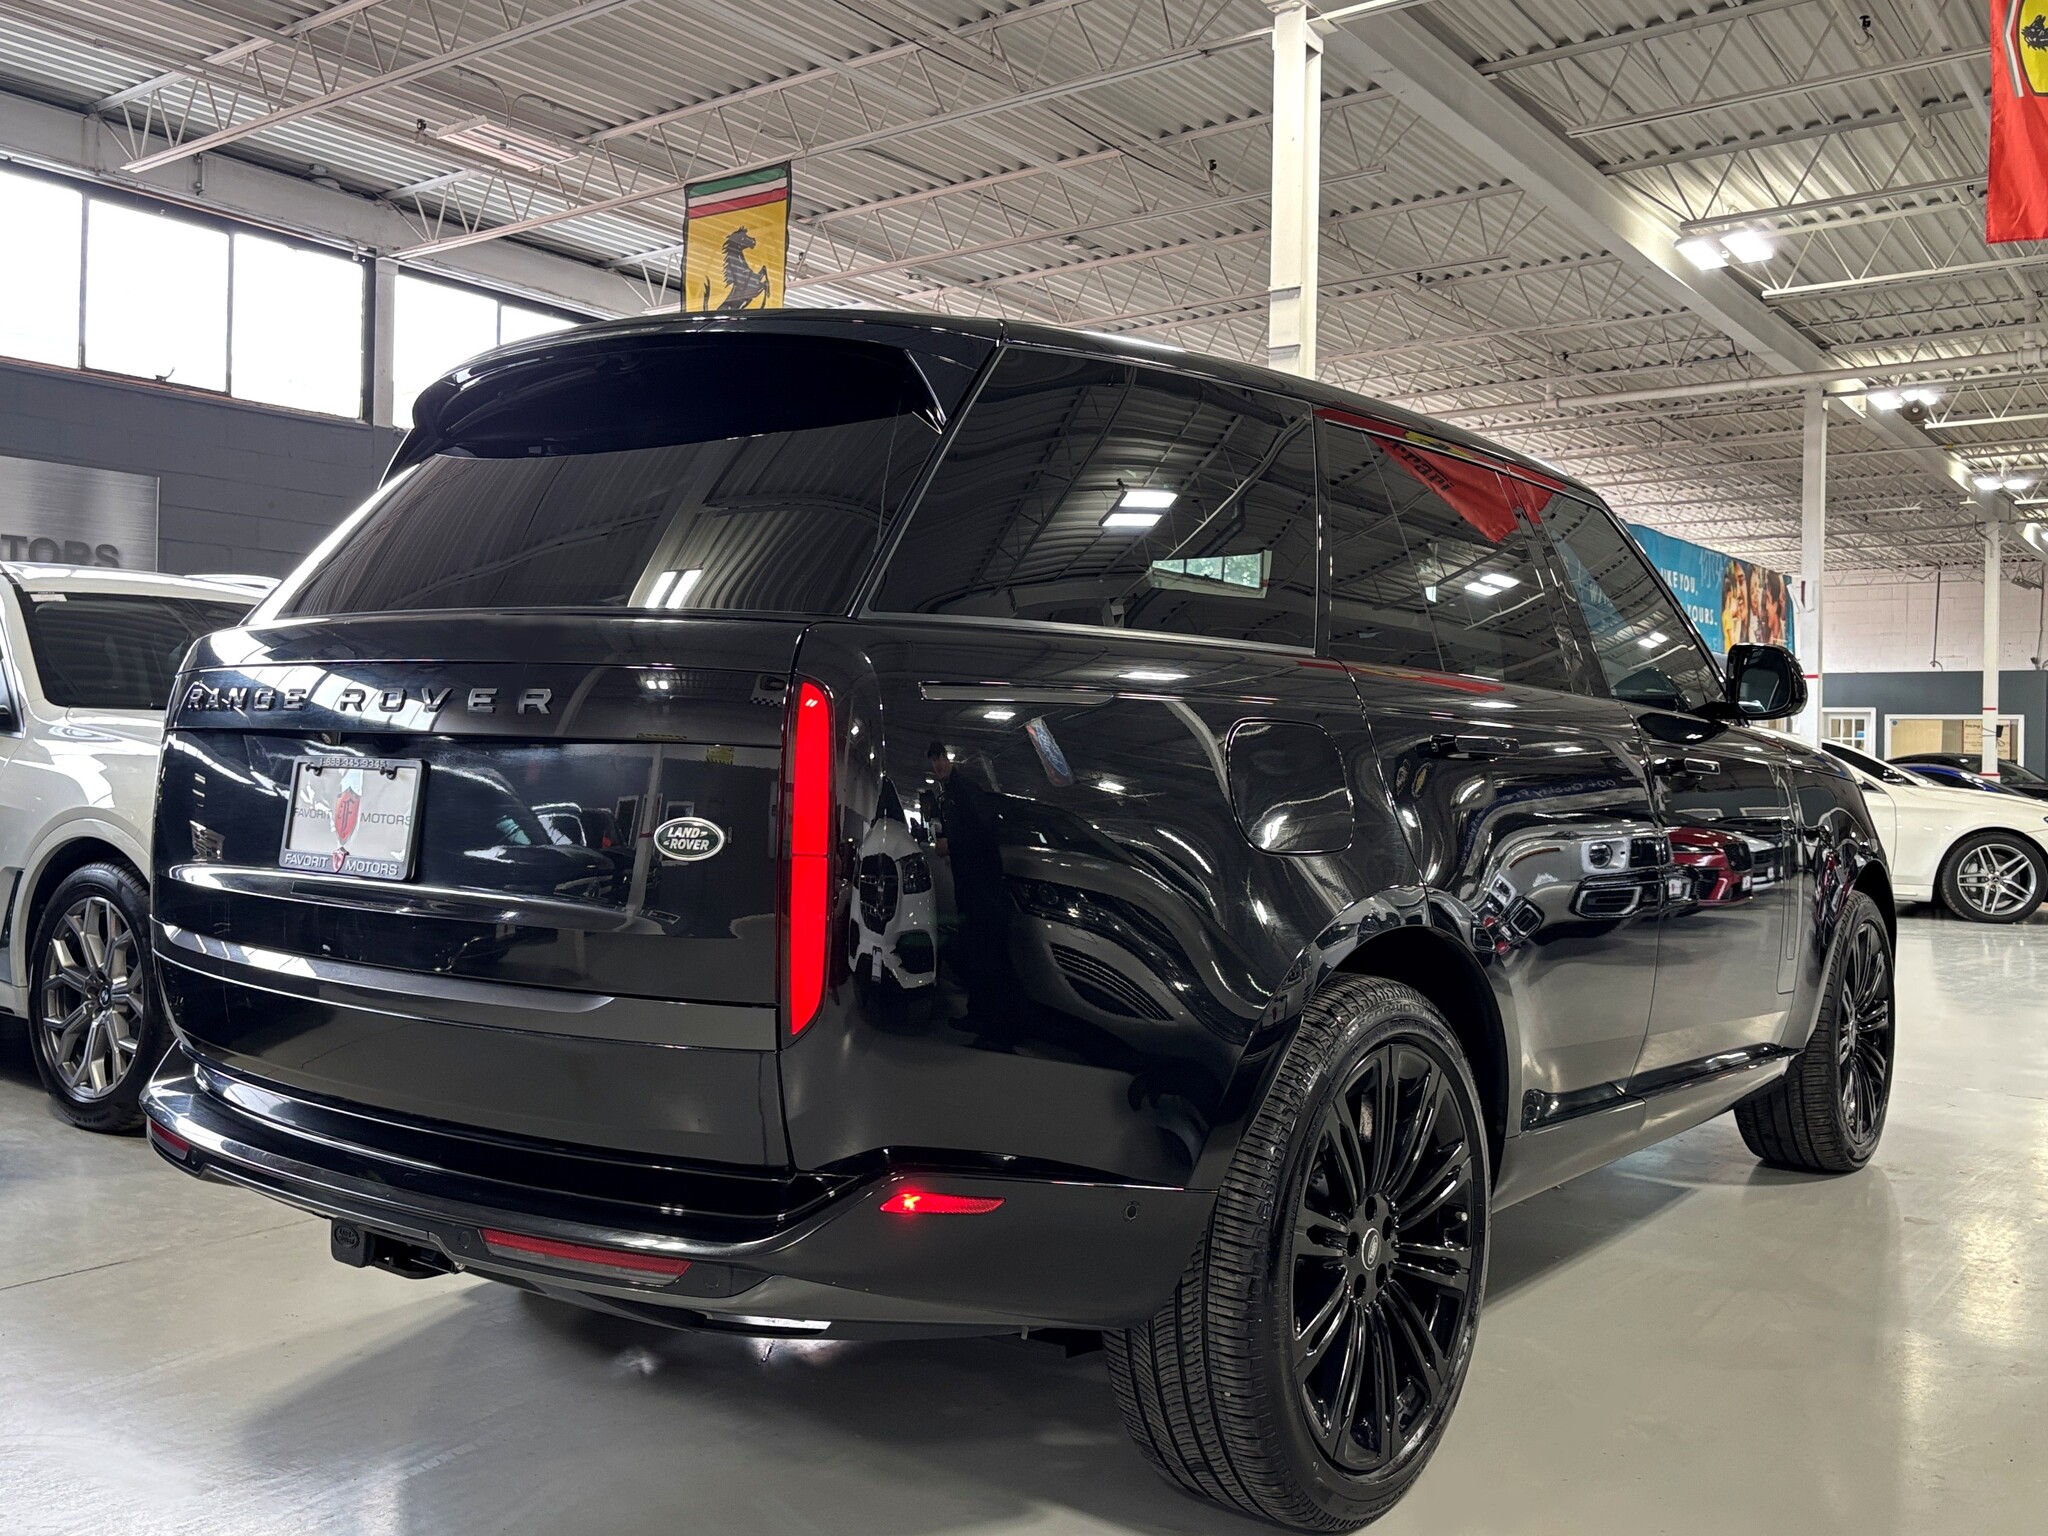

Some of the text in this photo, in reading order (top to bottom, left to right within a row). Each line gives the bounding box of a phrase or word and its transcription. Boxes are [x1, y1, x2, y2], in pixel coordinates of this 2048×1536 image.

[187, 687, 553, 715] RANGE ROVER
[294, 808, 411, 826] FAVORIT MOTORS
[668, 827, 701, 838] LAND
[669, 839, 709, 850] ROVER
[284, 854, 399, 876] FAVORIT MOTORS
